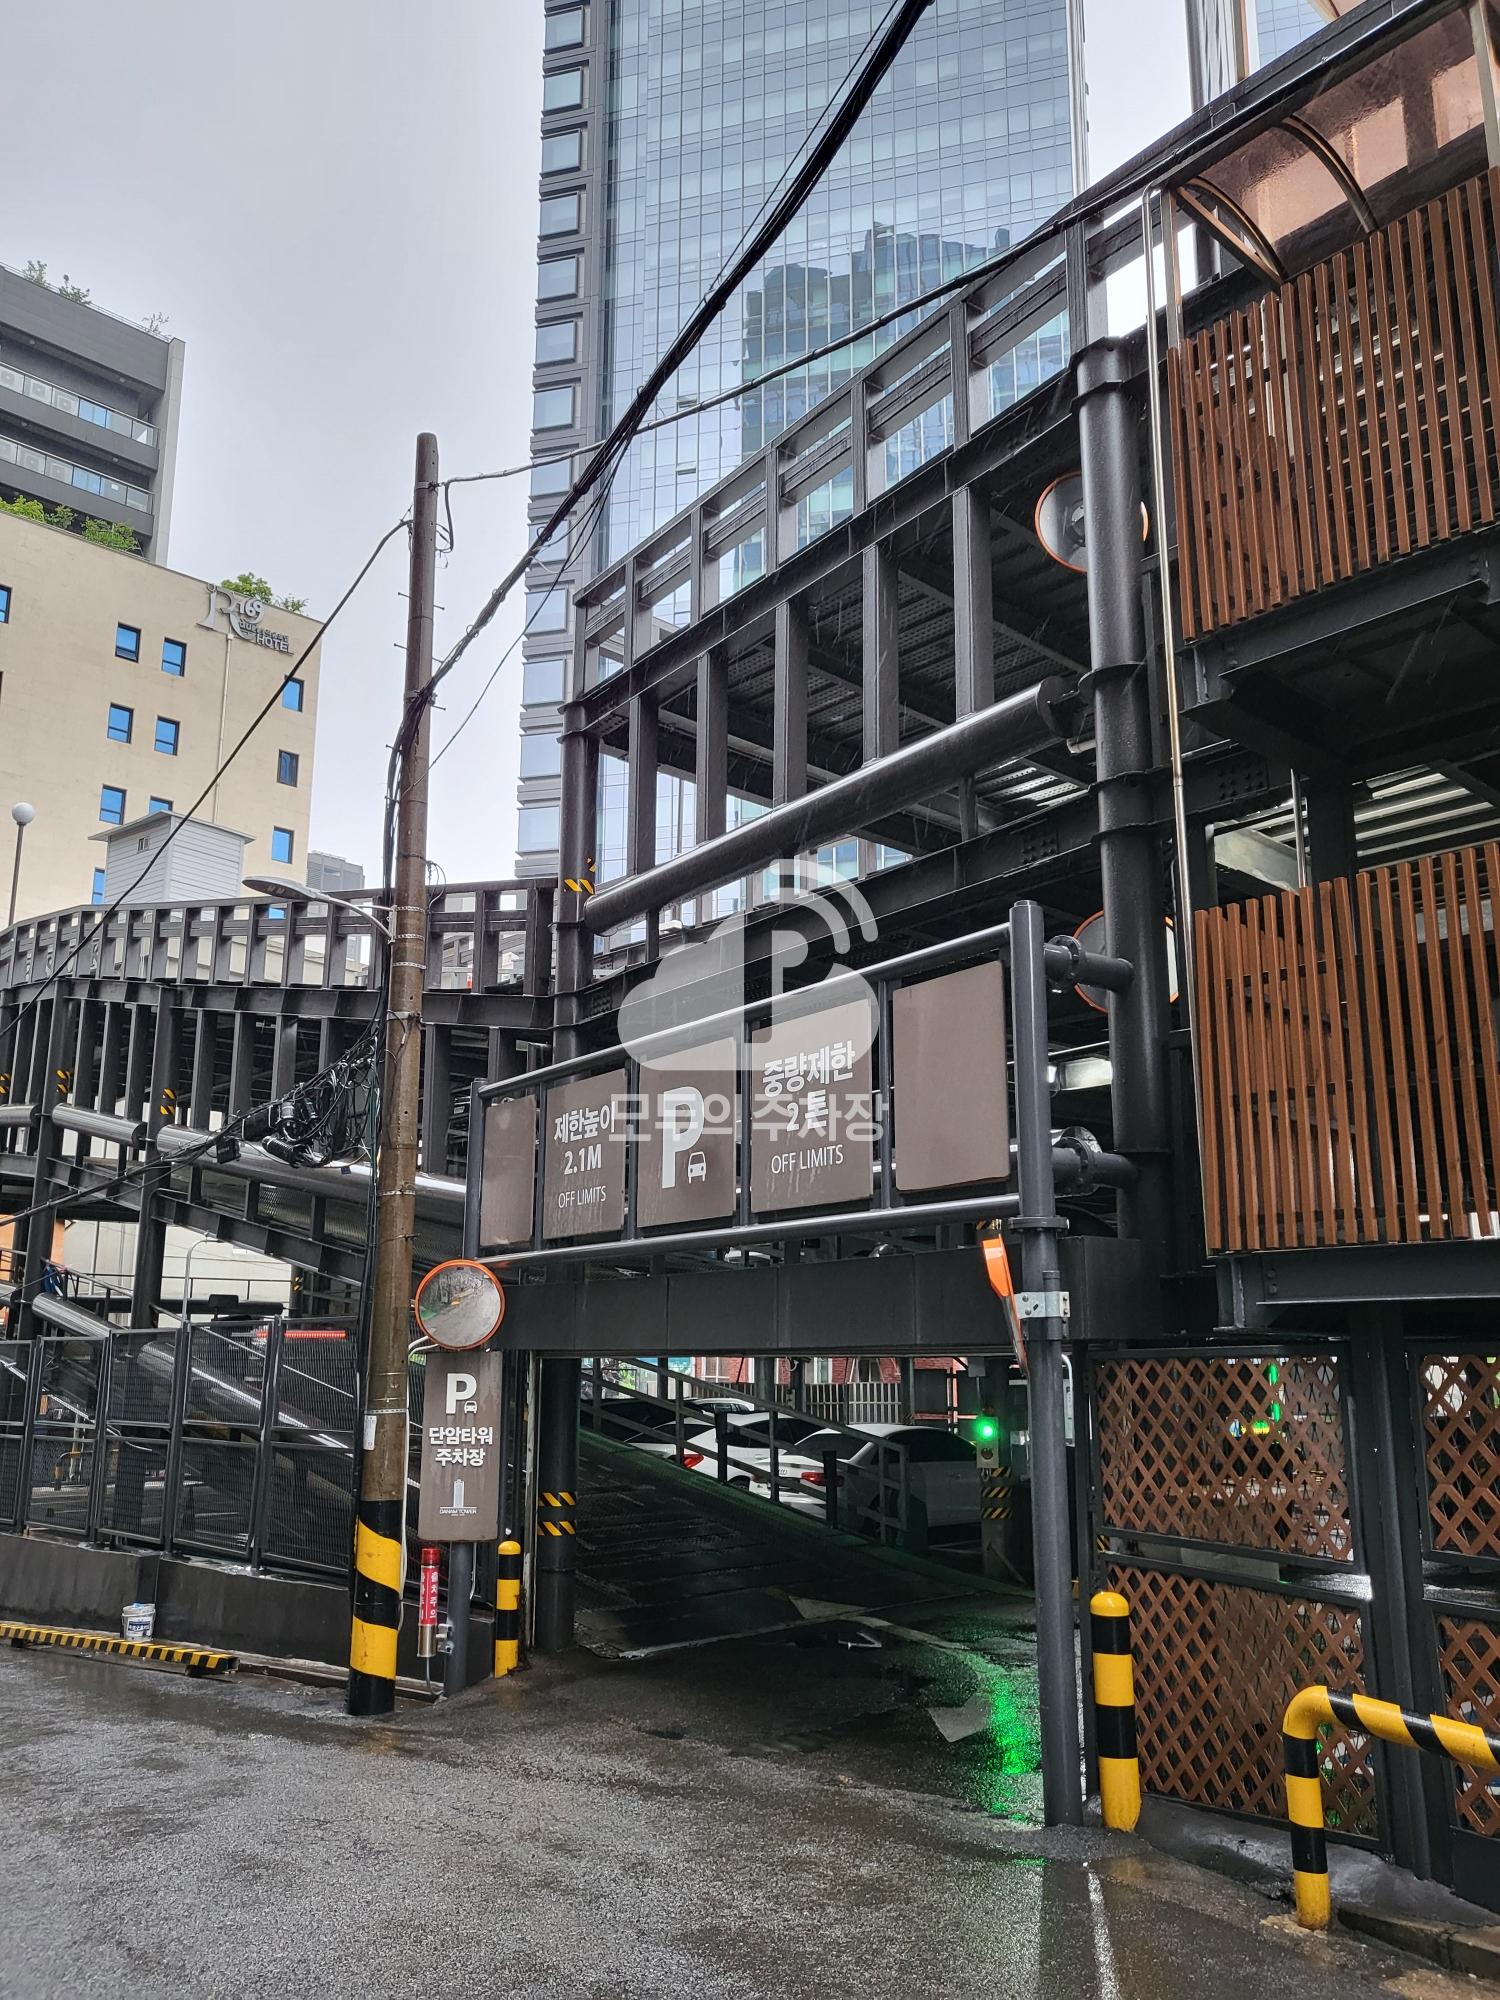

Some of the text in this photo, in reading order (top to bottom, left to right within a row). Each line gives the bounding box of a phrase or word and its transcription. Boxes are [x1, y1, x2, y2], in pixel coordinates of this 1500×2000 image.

[763, 1040, 855, 1097] 중량제한
[554, 1100, 615, 1143] 제한높이
[662, 1086, 704, 1189] P
[564, 1144, 602, 1175] 2.1M
[771, 1144, 844, 1174] OFF LIMITS
[558, 1185, 607, 1208] OFF LIMITS
[446, 1372, 477, 1415] P
[429, 1426, 494, 1446] 단암타워
[435, 1448, 486, 1467] 주차장
